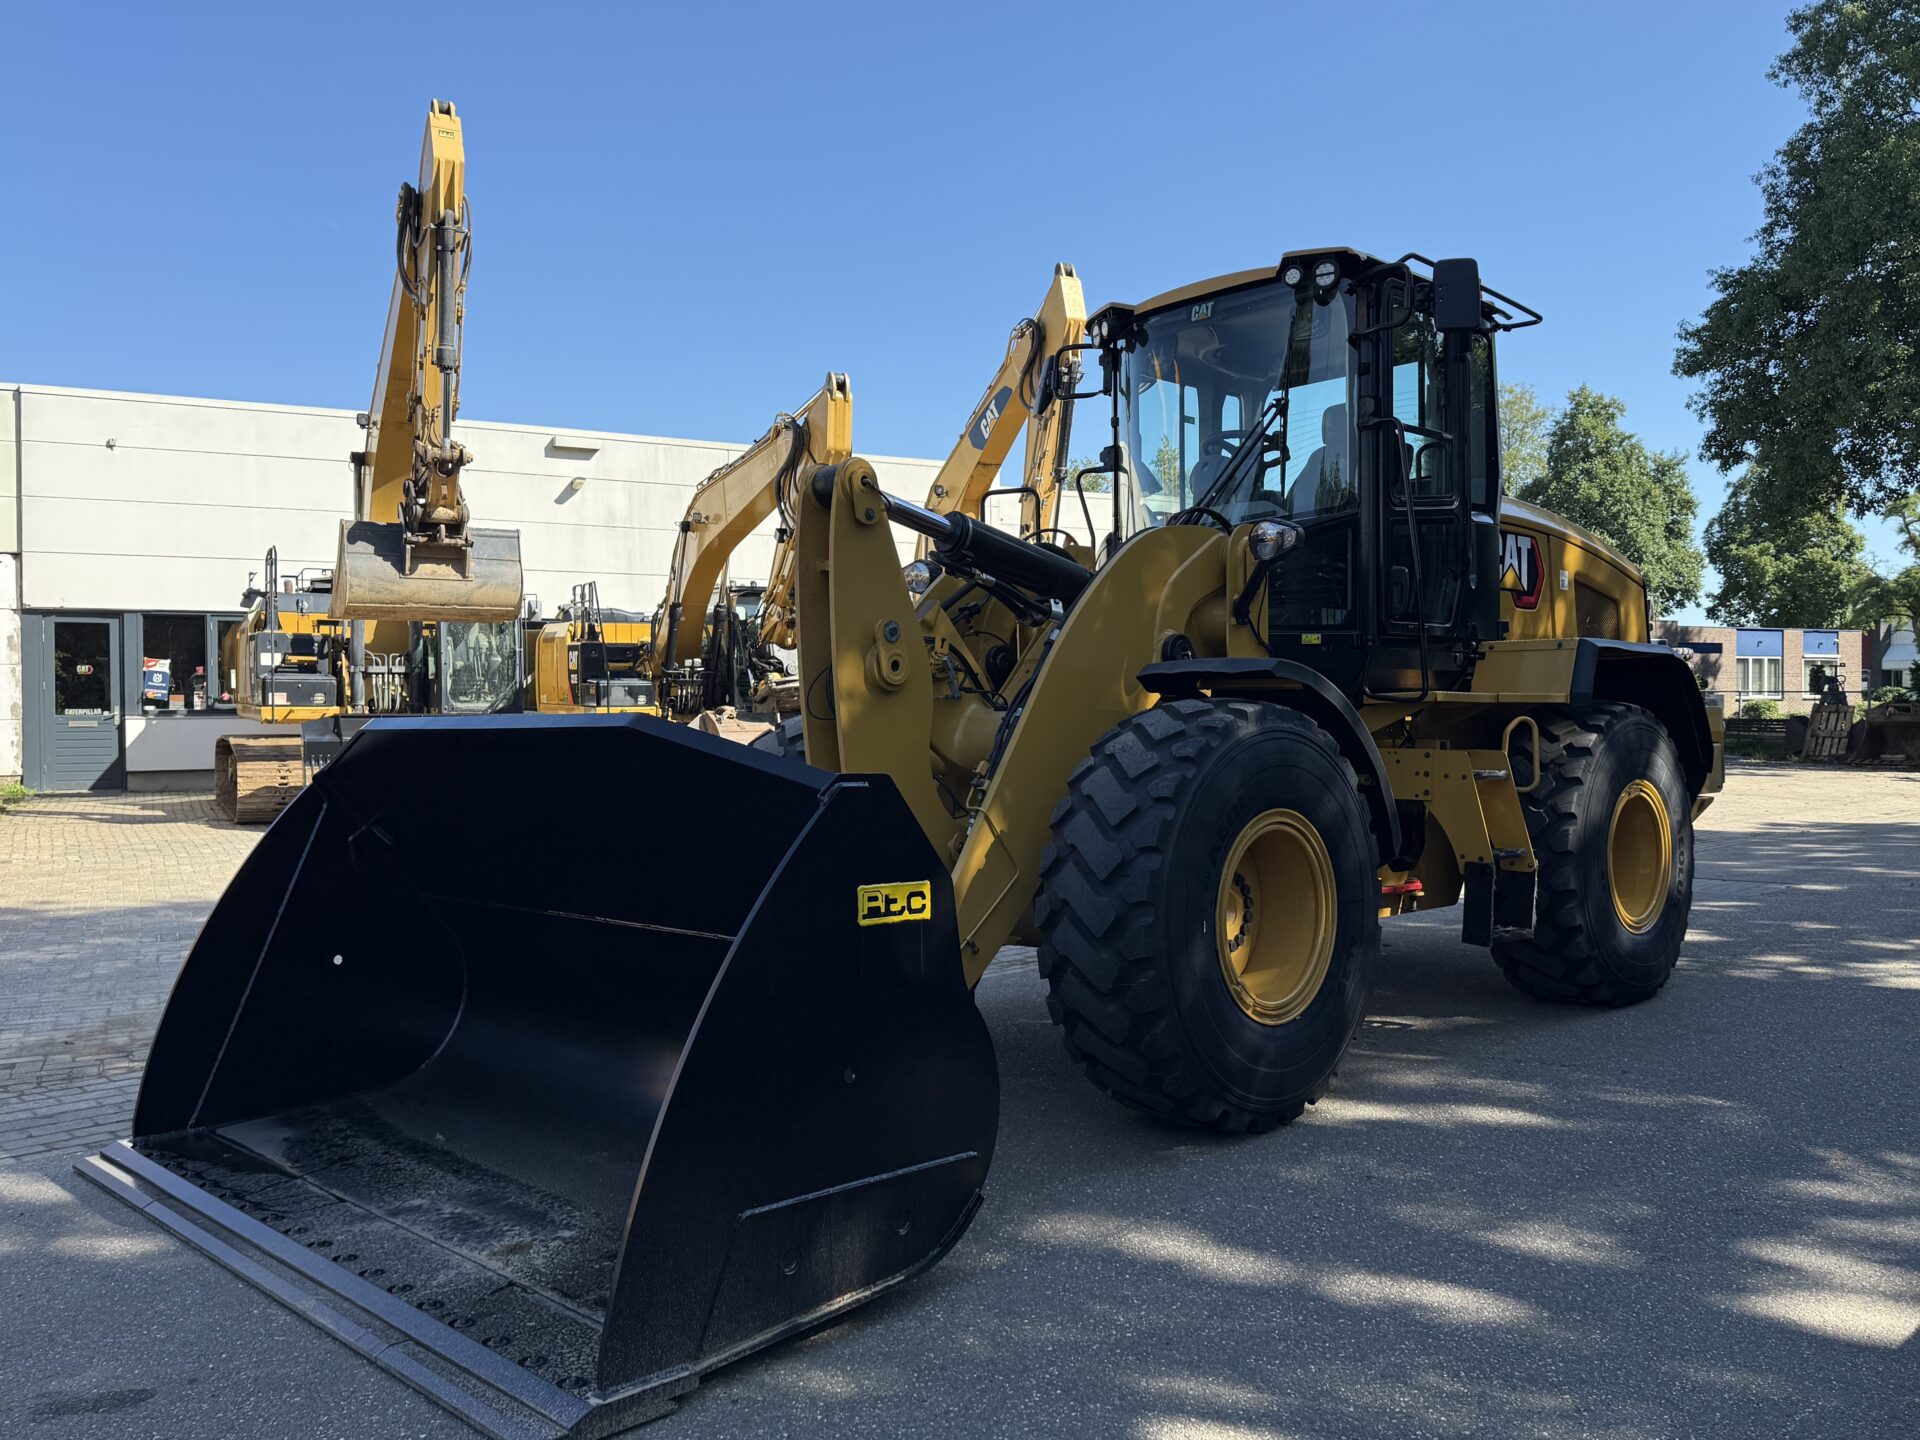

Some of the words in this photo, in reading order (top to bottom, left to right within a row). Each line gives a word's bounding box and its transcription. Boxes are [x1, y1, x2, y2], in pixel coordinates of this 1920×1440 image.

[1191, 301, 1214, 322] CAT
[981, 398, 999, 440] CAT
[1499, 533, 1531, 591] AT
[76, 664, 89, 674] CAT
[569, 650, 579, 670] CAT
[64, 708, 102, 716] CATERPILLAR
